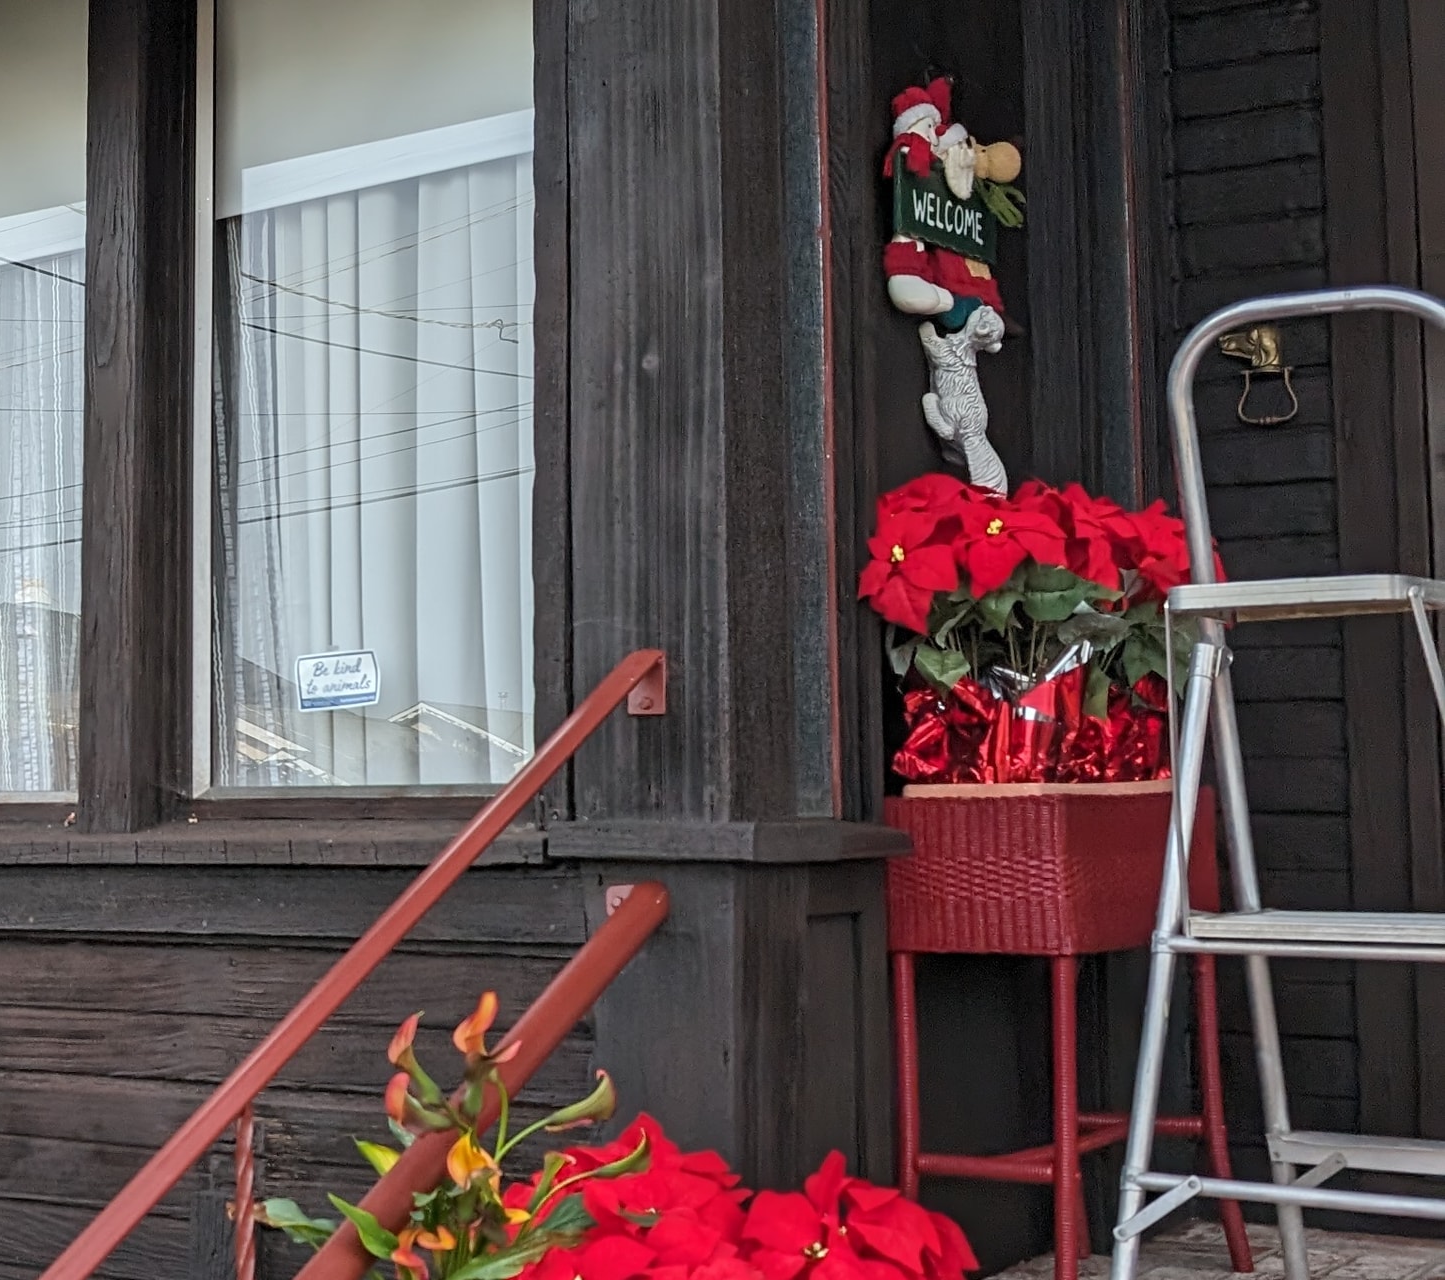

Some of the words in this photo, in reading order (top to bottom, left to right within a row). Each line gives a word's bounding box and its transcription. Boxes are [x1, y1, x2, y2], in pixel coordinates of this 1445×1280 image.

[912, 188, 984, 246] WELCOME
[313, 661, 329, 677] Be
[334, 657, 362, 675] kind
[307, 679, 318, 695] to
[322, 673, 371, 693] animals
